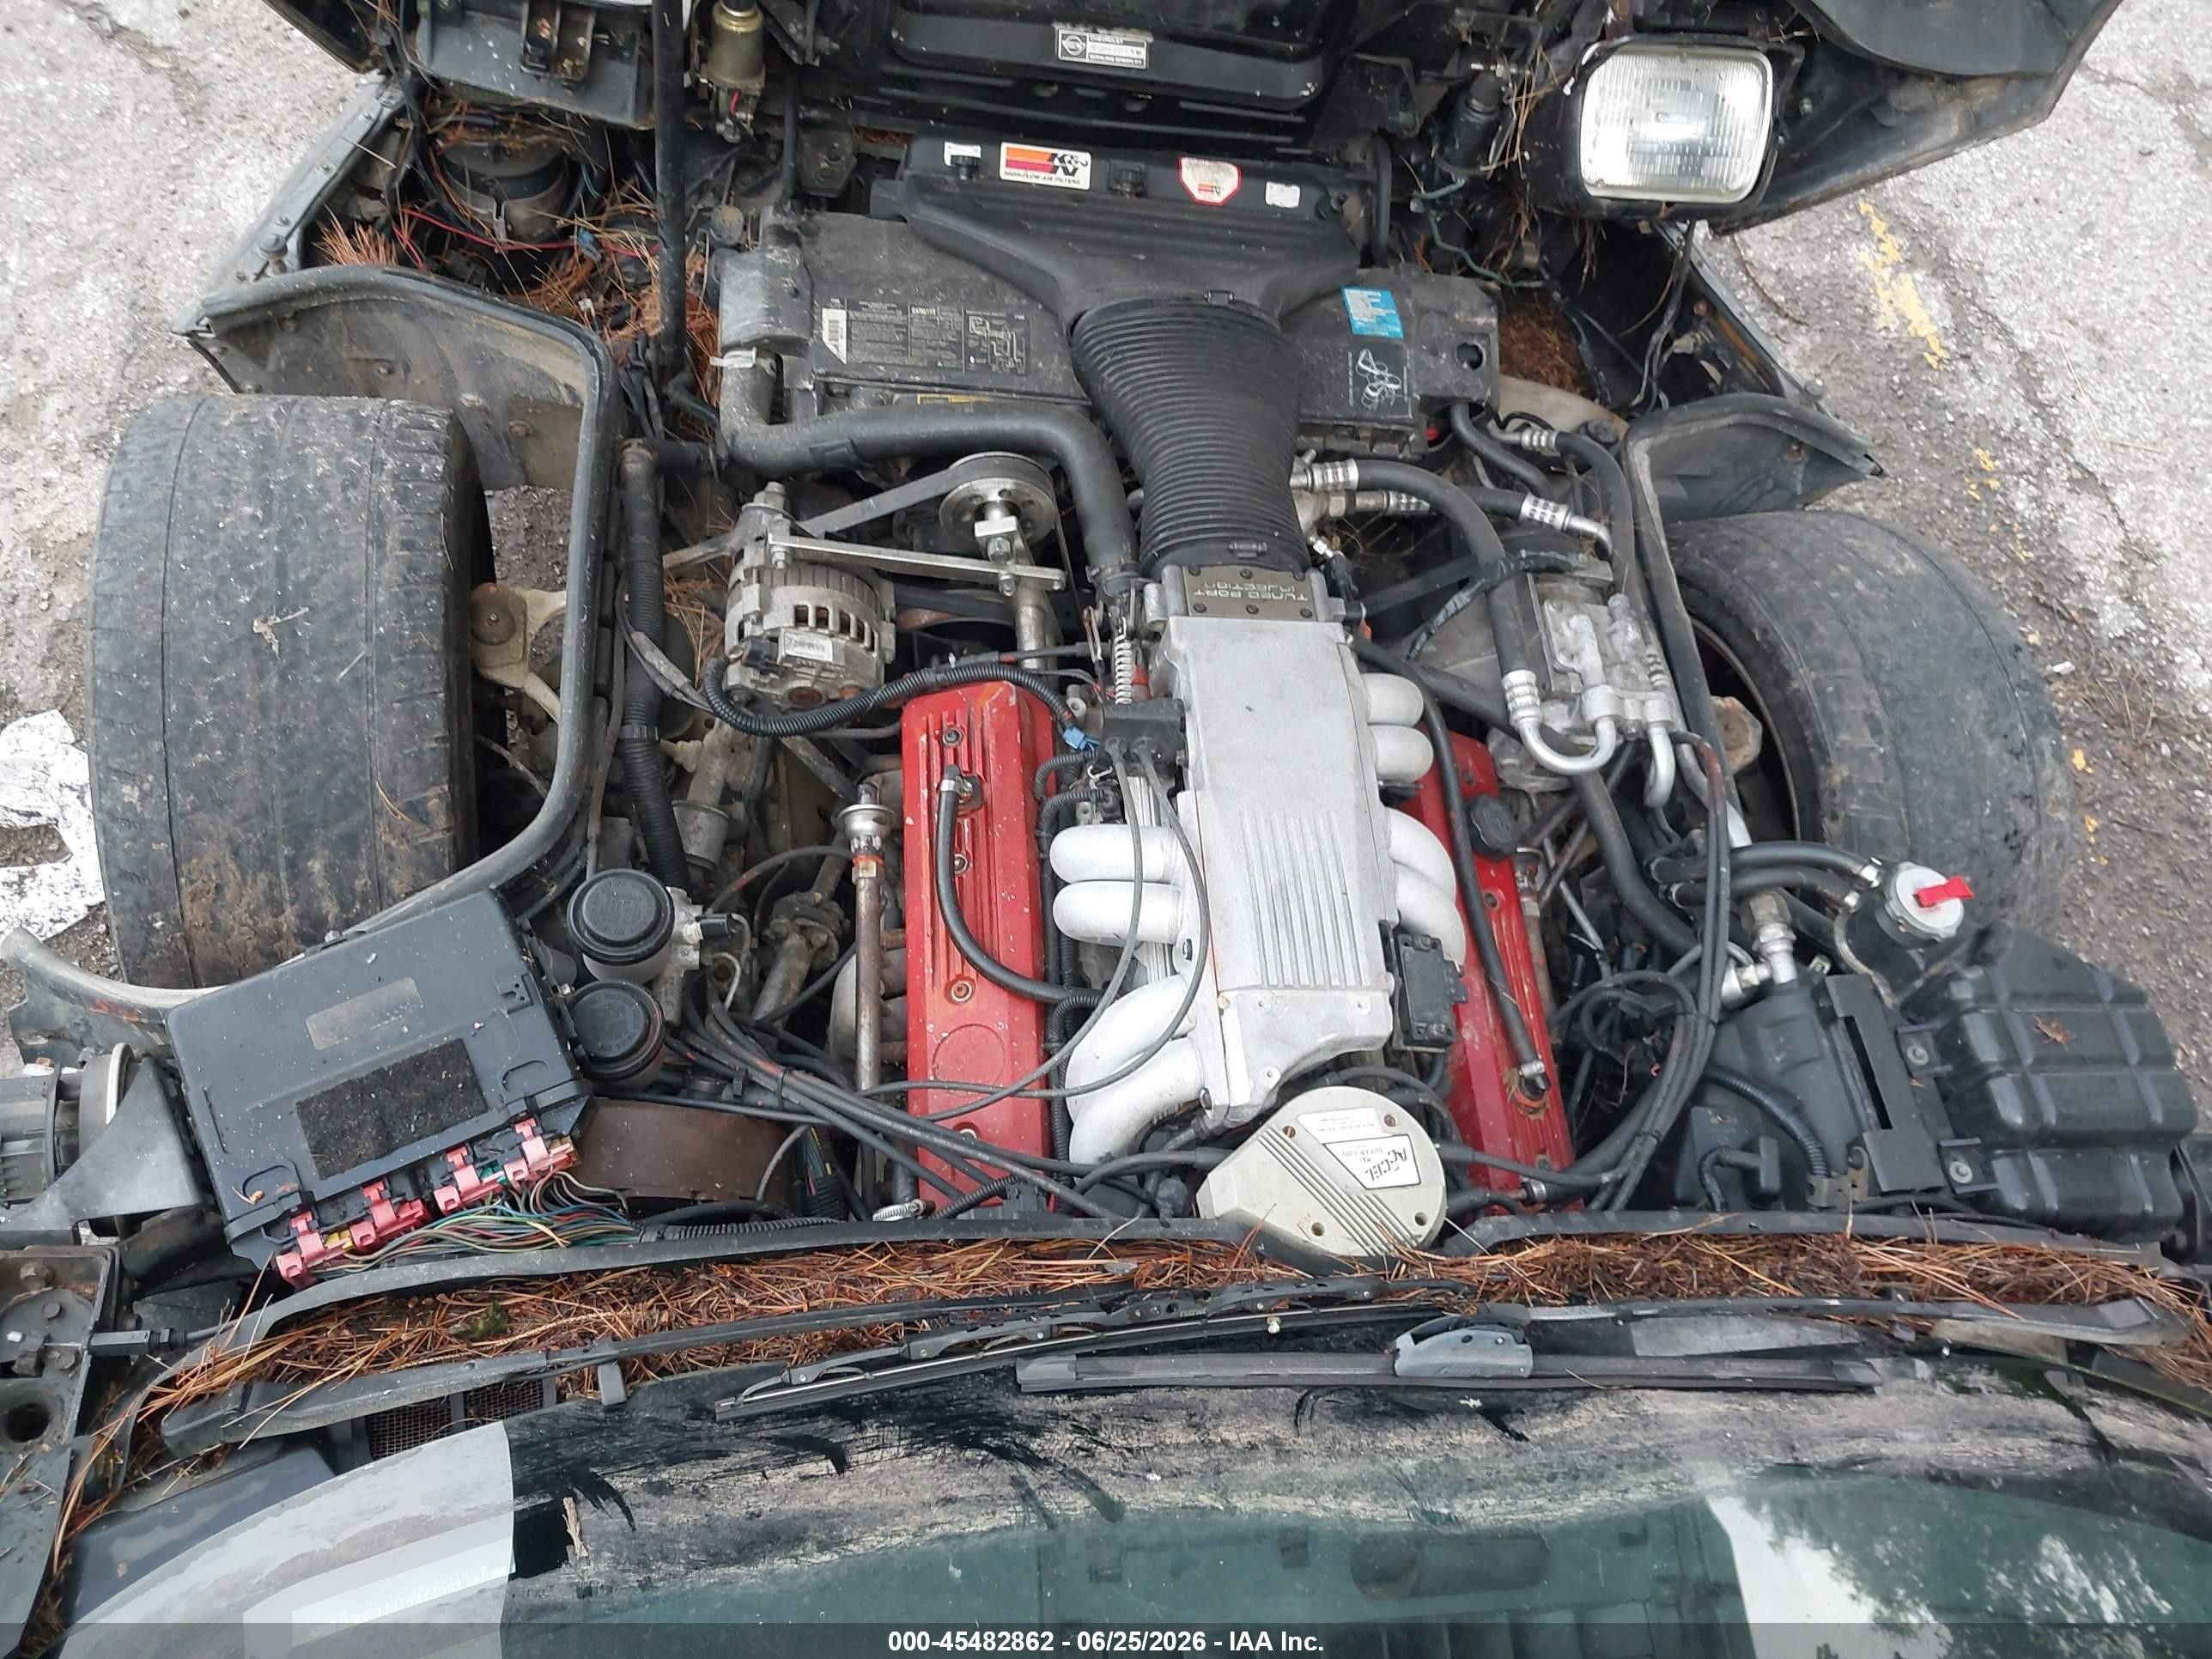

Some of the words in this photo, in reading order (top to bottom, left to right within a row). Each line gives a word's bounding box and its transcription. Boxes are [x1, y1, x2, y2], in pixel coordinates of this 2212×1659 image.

[1204, 581, 1295, 592] INJECTION
[1194, 588, 1242, 599] PORT
[1248, 590, 1308, 601] TUNED
[1364, 1147, 1407, 1182] ACCEL
